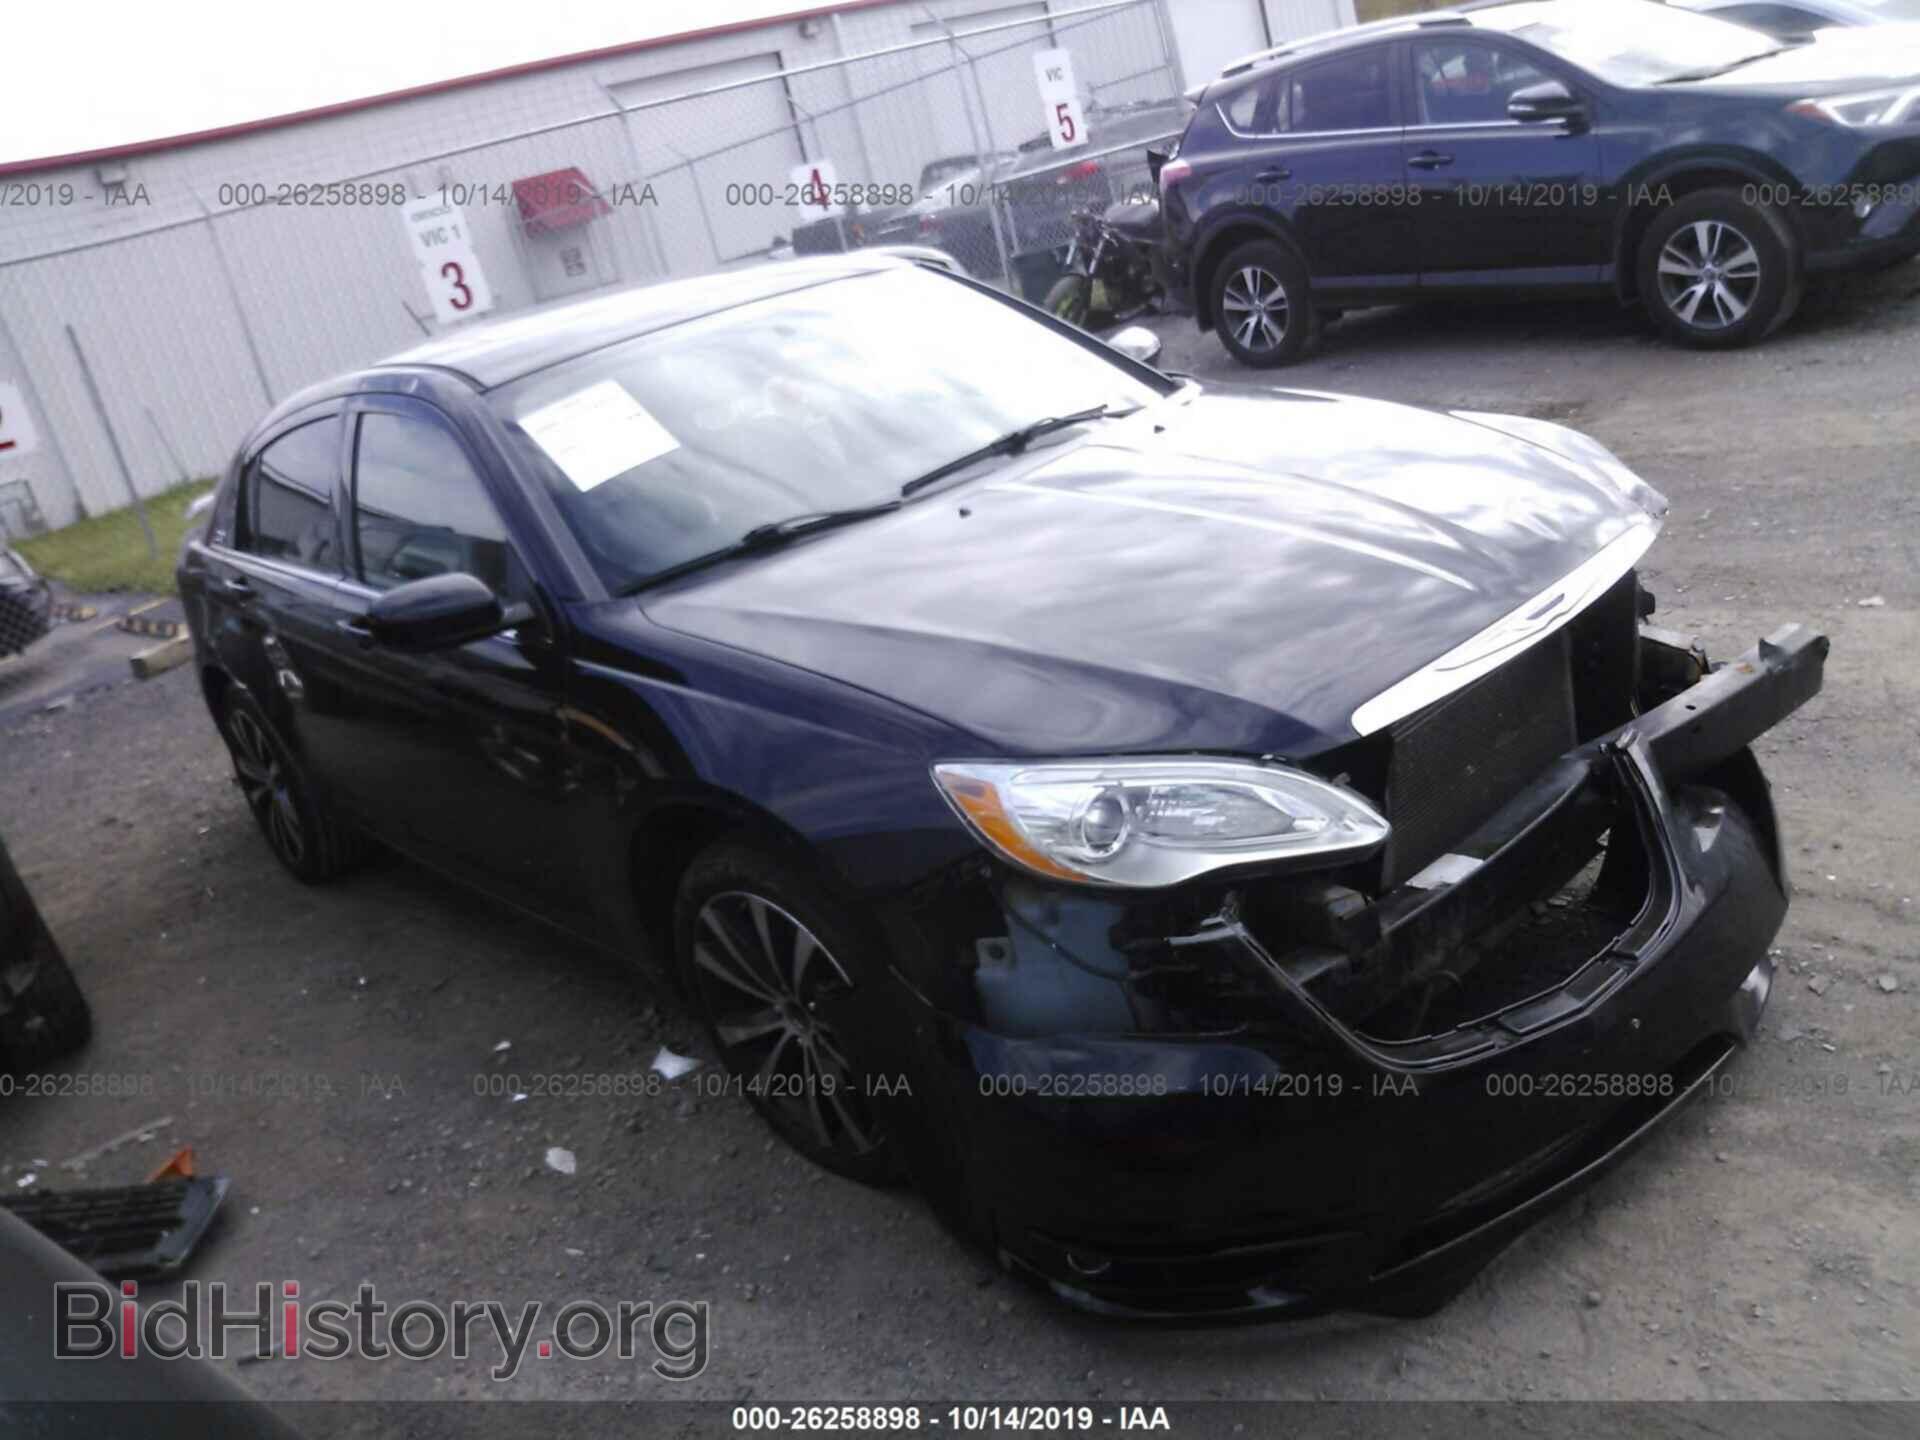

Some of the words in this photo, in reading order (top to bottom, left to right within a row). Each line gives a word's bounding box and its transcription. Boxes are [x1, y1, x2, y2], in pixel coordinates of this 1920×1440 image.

[1056, 103, 1075, 143] 5
[810, 168, 829, 211] 4
[441, 261, 474, 311] 3
